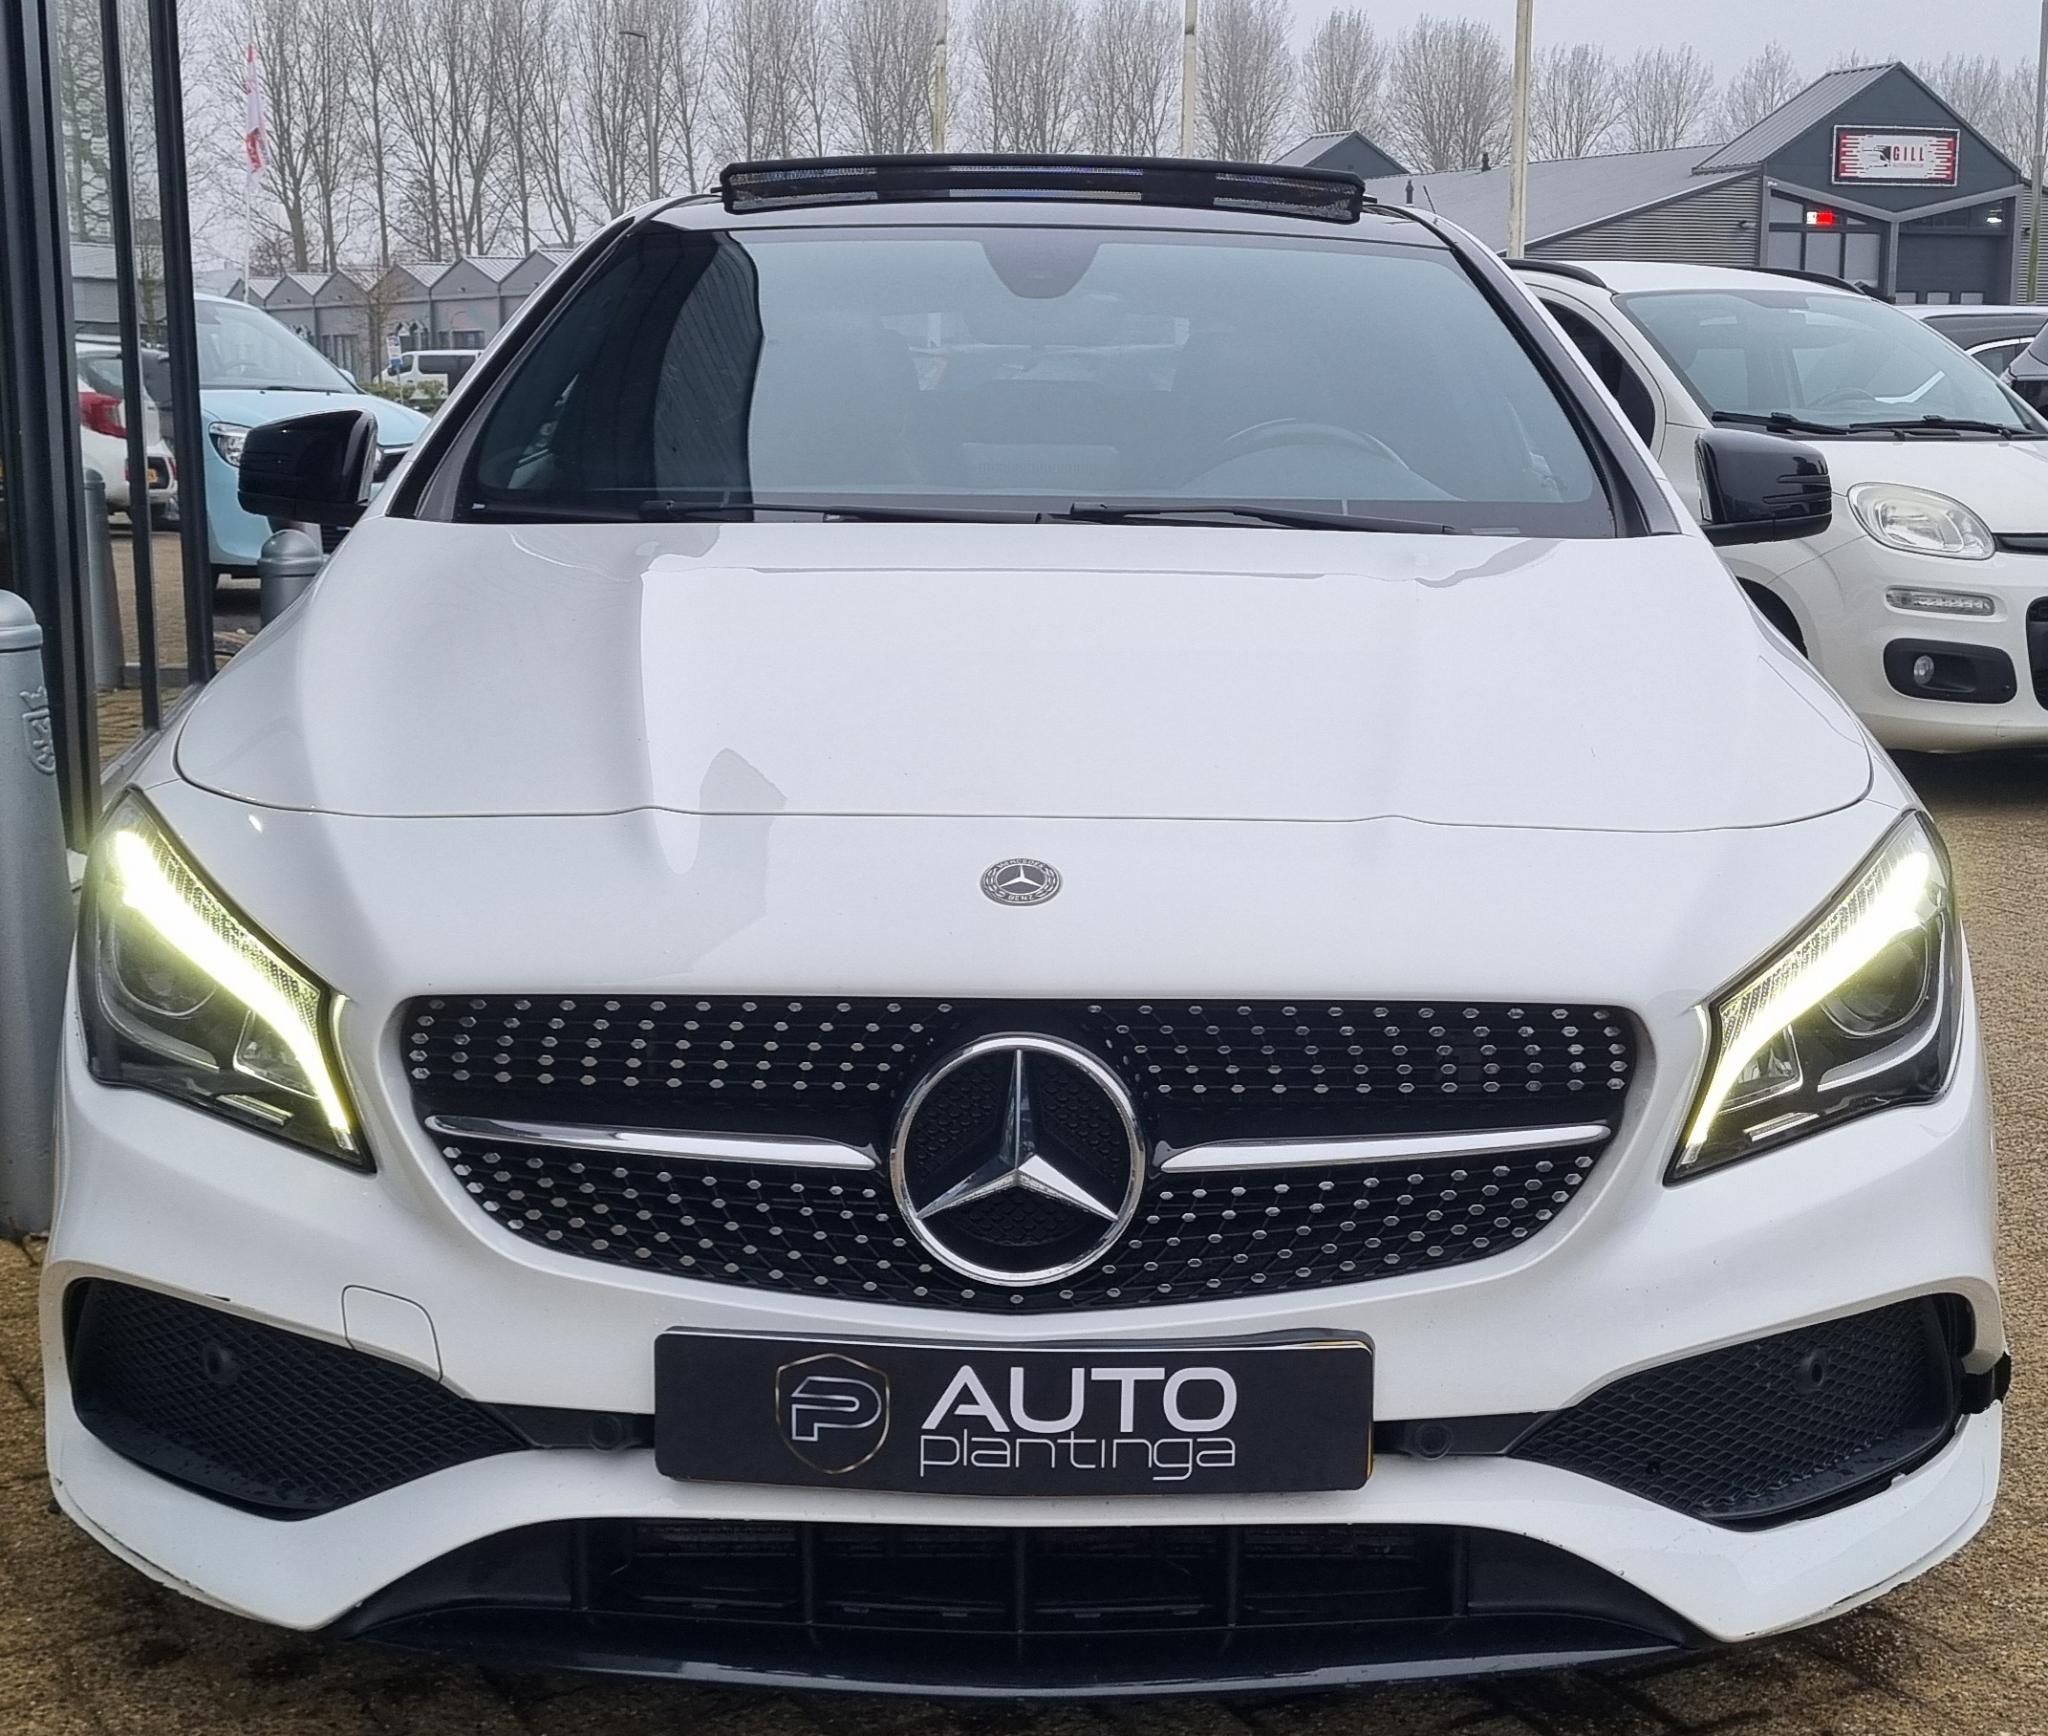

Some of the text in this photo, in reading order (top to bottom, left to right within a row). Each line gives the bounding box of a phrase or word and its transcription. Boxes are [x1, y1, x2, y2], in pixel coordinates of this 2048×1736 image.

[1893, 146, 1924, 161] GILL
[921, 1365, 1238, 1433] AUTO
[921, 1429, 1236, 1480] plantinga
